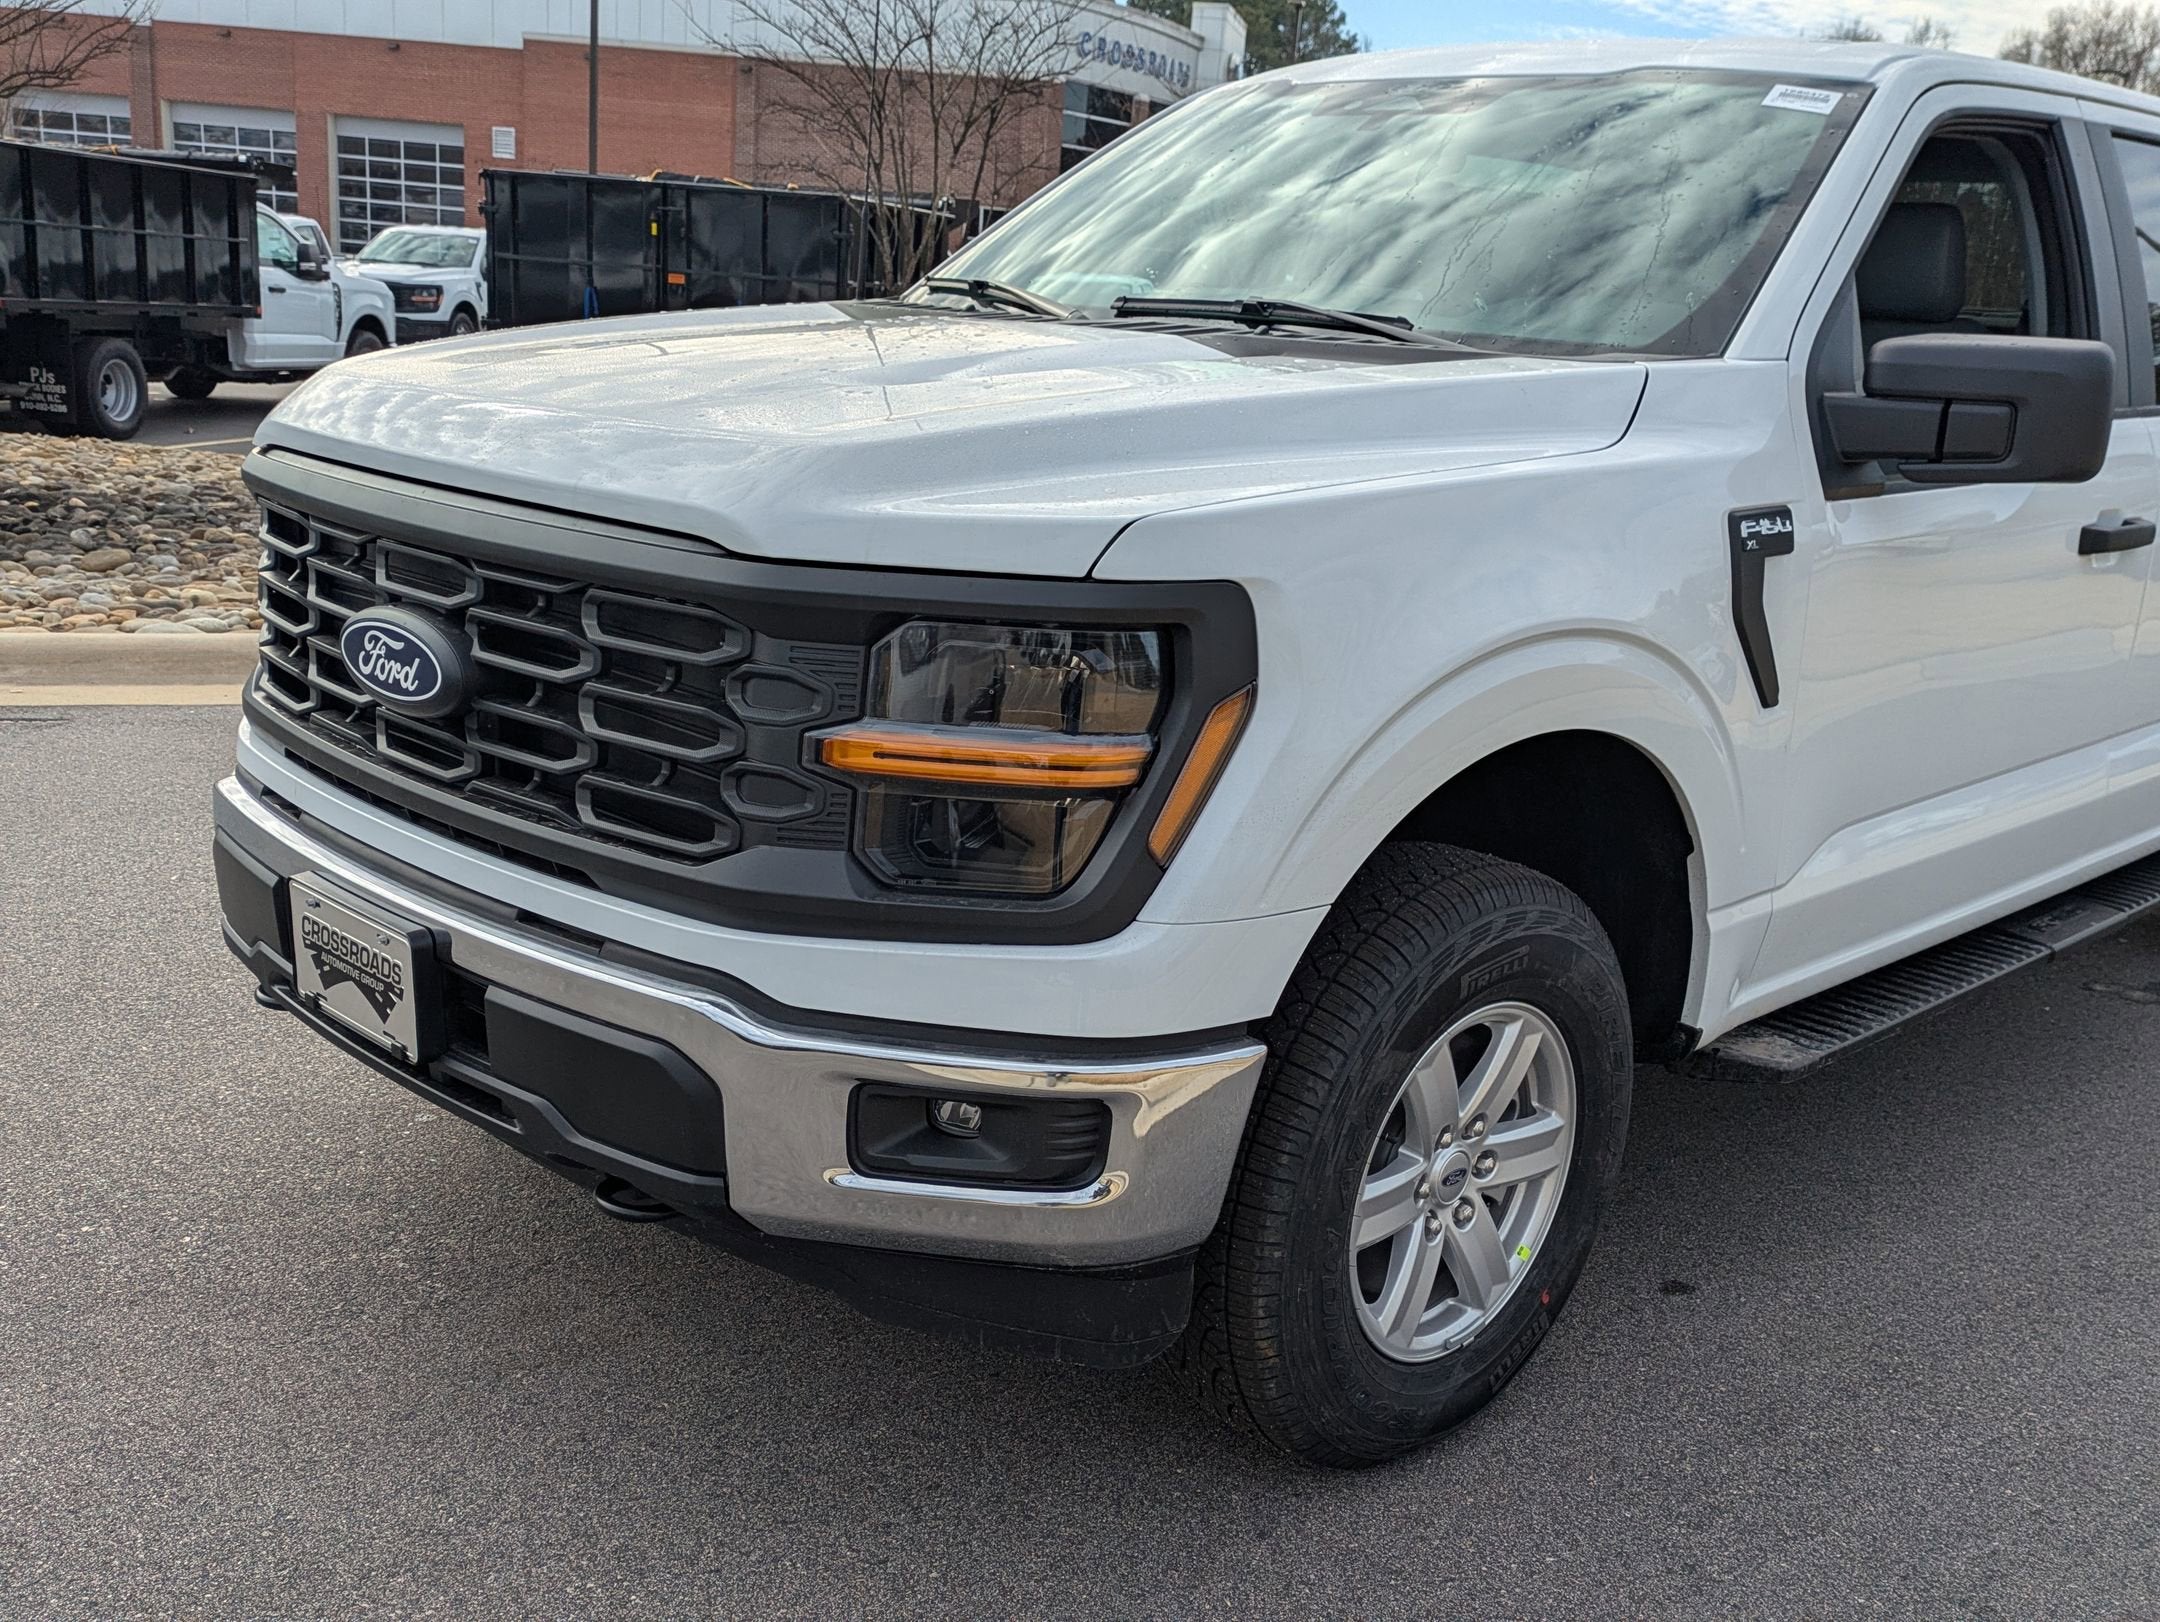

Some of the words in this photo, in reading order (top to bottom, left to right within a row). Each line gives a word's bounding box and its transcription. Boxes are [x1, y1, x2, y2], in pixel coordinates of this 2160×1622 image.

[29, 366, 56, 384] PJs
[1746, 539, 1759, 550] XL
[358, 630, 421, 692] Ford
[301, 914, 403, 985] CROSSROADS
[320, 951, 361, 980] AUTOMOTIVE
[360, 972, 385, 993] GROUP
[1459, 944, 1531, 1000] PIRELLI
[1488, 1311, 1551, 1394] PIRELLI
